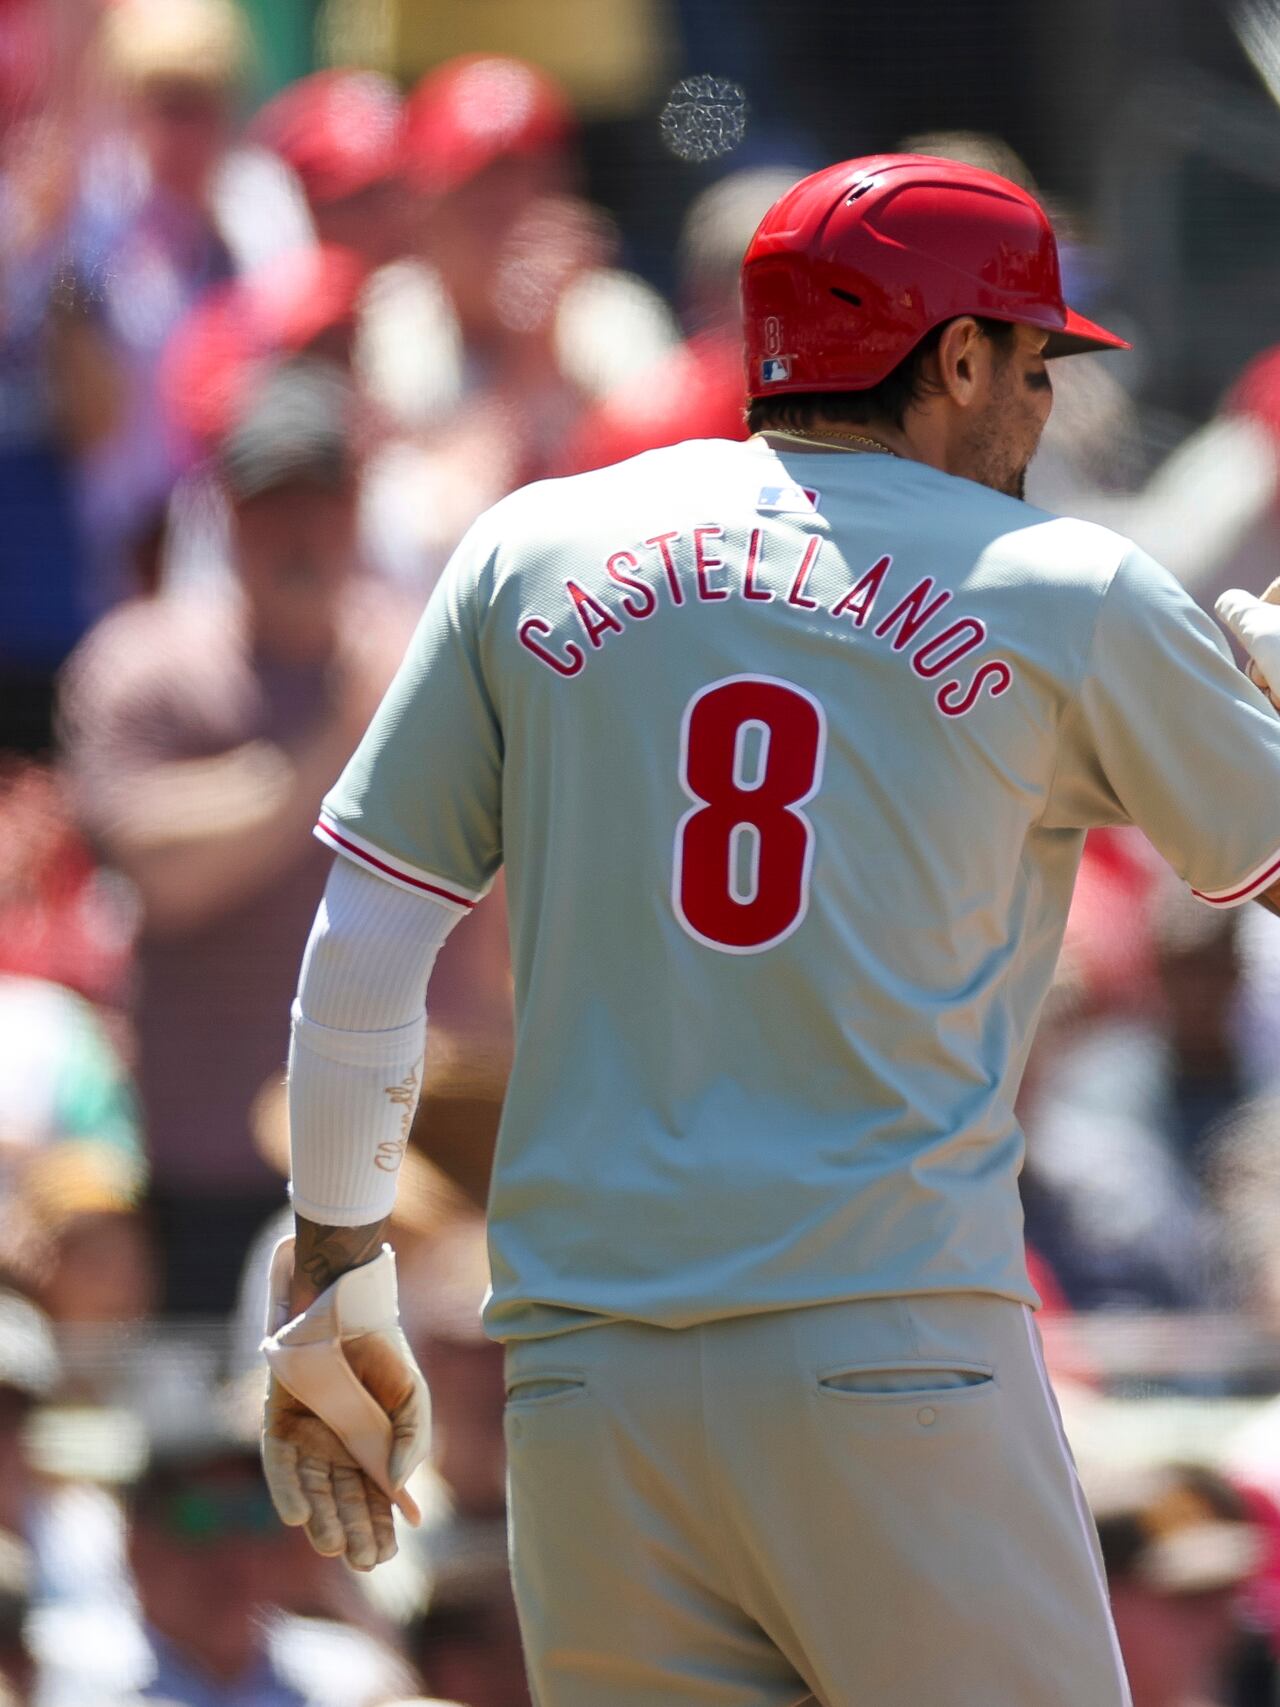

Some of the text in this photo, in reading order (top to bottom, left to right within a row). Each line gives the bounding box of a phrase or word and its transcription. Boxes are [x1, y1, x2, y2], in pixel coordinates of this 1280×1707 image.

[764, 315, 780, 356] 8
[517, 525, 1012, 717] CASTELLANOS
[673, 673, 827, 955] 8
